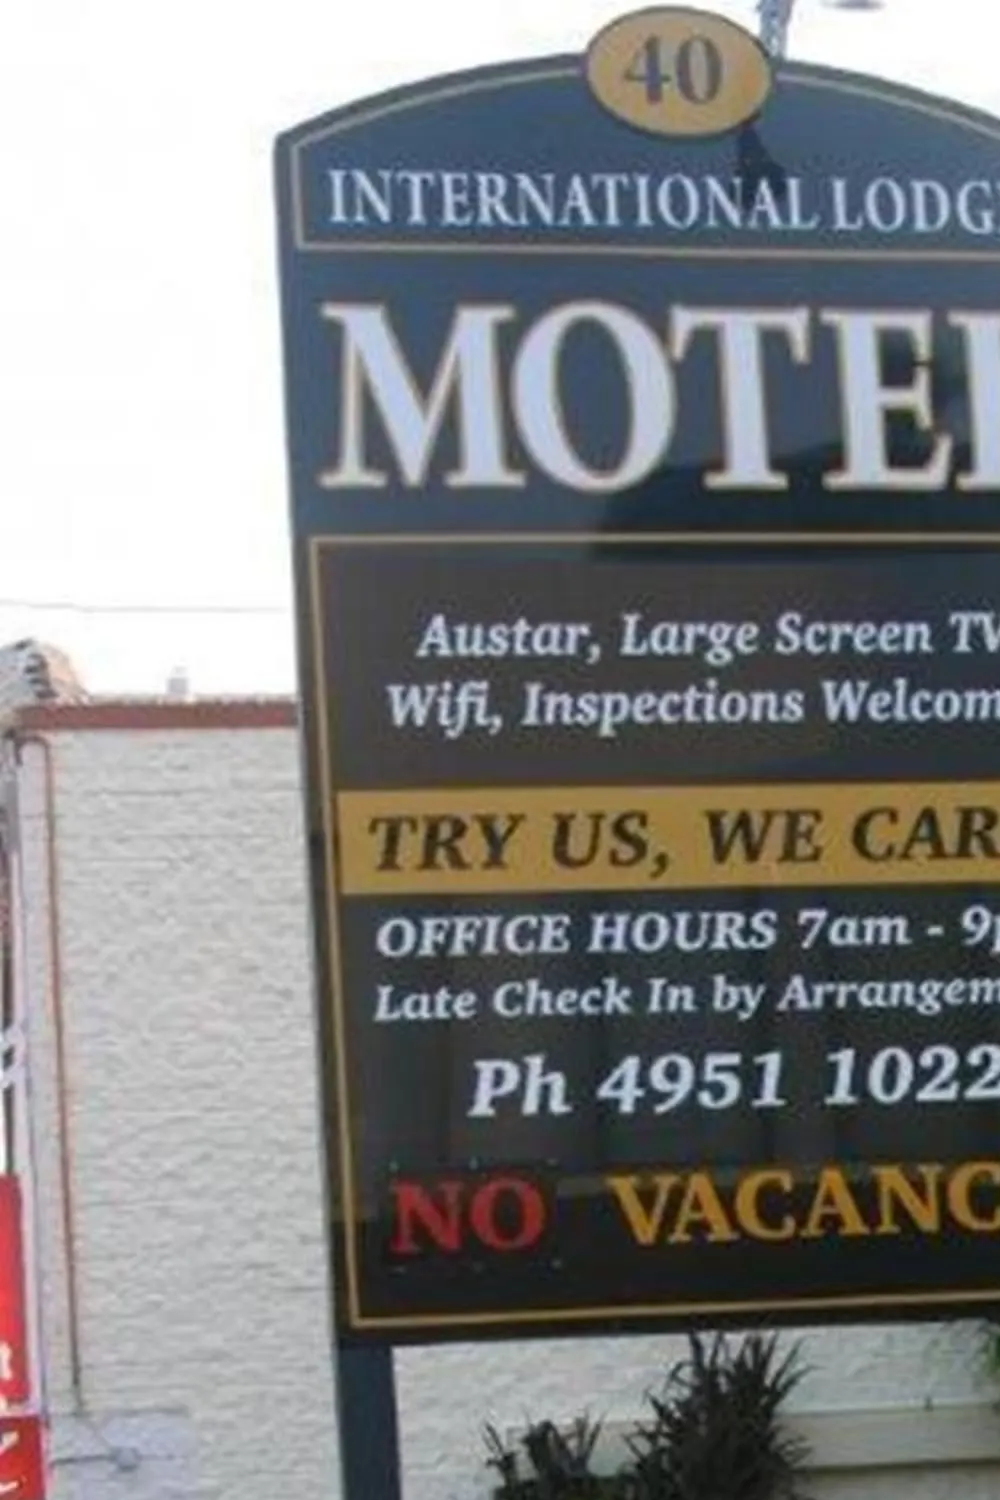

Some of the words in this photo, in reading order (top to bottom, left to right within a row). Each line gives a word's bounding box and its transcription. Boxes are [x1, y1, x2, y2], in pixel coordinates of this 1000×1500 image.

[623, 37, 721, 104] 40
[328, 168, 821, 232] INTERNATIONAL
[416, 613, 602, 664] Austar,
[620, 612, 758, 667] Large
[774, 612, 933, 655] Screen
[386, 680, 503, 738] Wifi,
[520, 679, 804, 738] Inspections
[368, 812, 525, 872] TRY
[550, 810, 671, 878] US,
[705, 807, 823, 864] WE
[374, 914, 572, 957] OFFICE
[587, 911, 778, 952] HOURS
[799, 908, 912, 949] 7am
[373, 984, 477, 1022] Late
[492, 980, 632, 1018] Check
[648, 977, 697, 1013] In
[713, 975, 765, 1020] by
[467, 1053, 573, 1118] Ph
[596, 1050, 787, 1114] 4951
[387, 1177, 549, 1256] NO
